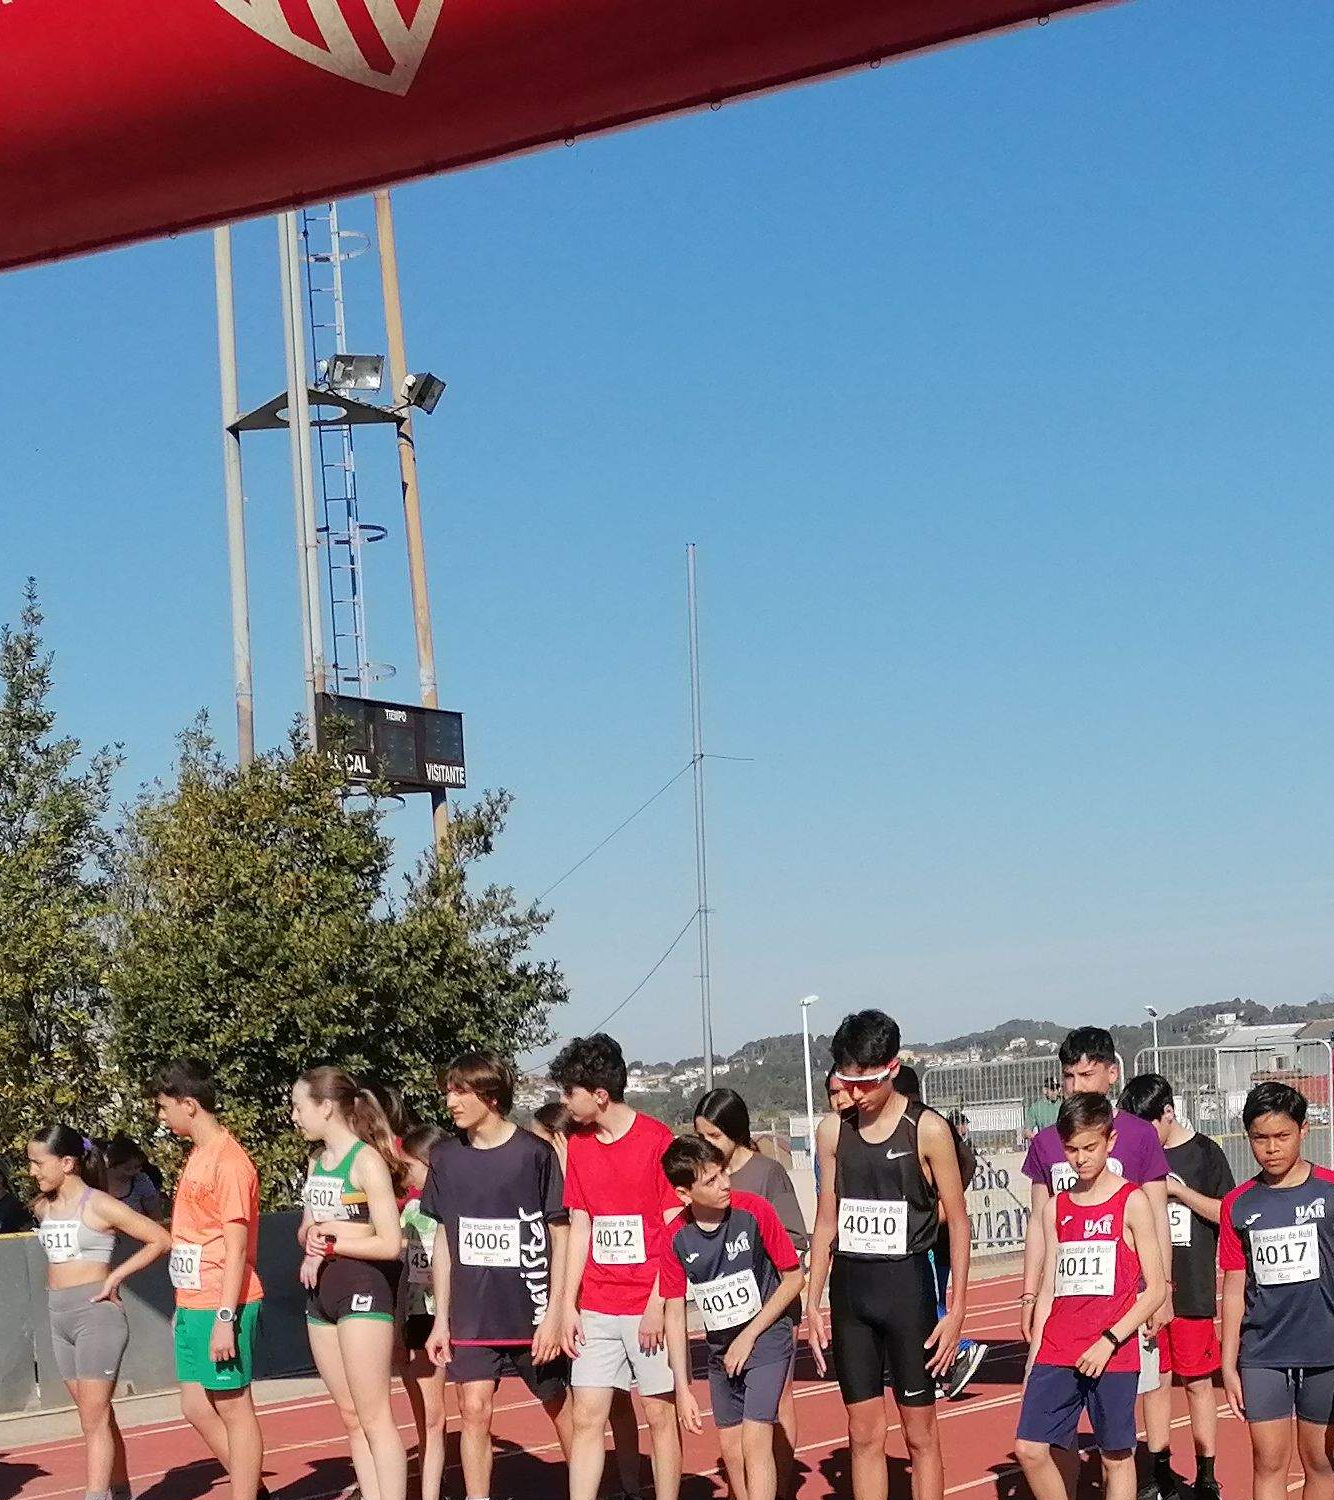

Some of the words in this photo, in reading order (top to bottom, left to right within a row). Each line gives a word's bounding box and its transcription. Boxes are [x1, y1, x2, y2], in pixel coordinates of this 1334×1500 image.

[425, 762, 465, 785] VISITANTE
[972, 1161, 1009, 1191] Bio
[844, 1215, 896, 1235] 4010
[464, 1232, 510, 1250] 4006
[596, 1230, 635, 1247] 4012
[1256, 1242, 1307, 1265] 4017
[1058, 1257, 1103, 1277] 4011
[703, 1286, 750, 1314] 4019
